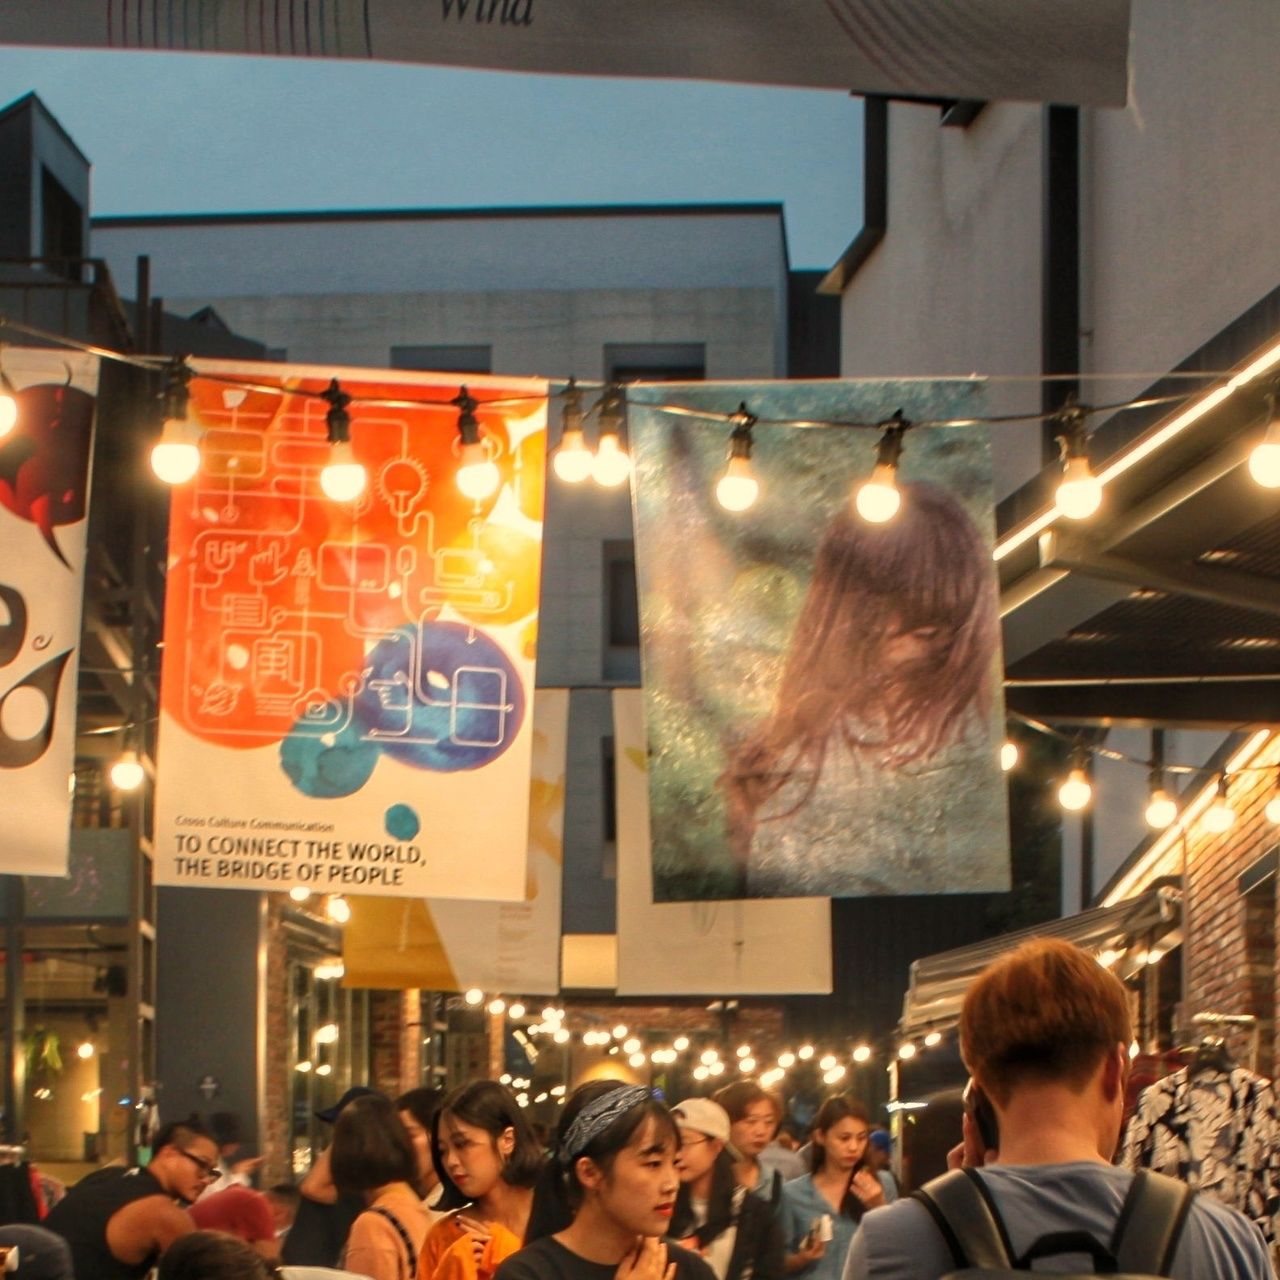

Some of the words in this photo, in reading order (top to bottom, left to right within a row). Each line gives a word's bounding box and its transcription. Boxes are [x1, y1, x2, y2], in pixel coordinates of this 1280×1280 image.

[250, 818, 335, 833] Communication
[175, 834, 201, 854] TO
[207, 836, 299, 858] CONNECT
[306, 840, 343, 861] THE
[347, 842, 426, 867] WORLD,
[175, 857, 210, 877] THE
[217, 860, 292, 881] BRIDGE
[297, 862, 323, 882] OF
[328, 865, 404, 886] PEOPLE
